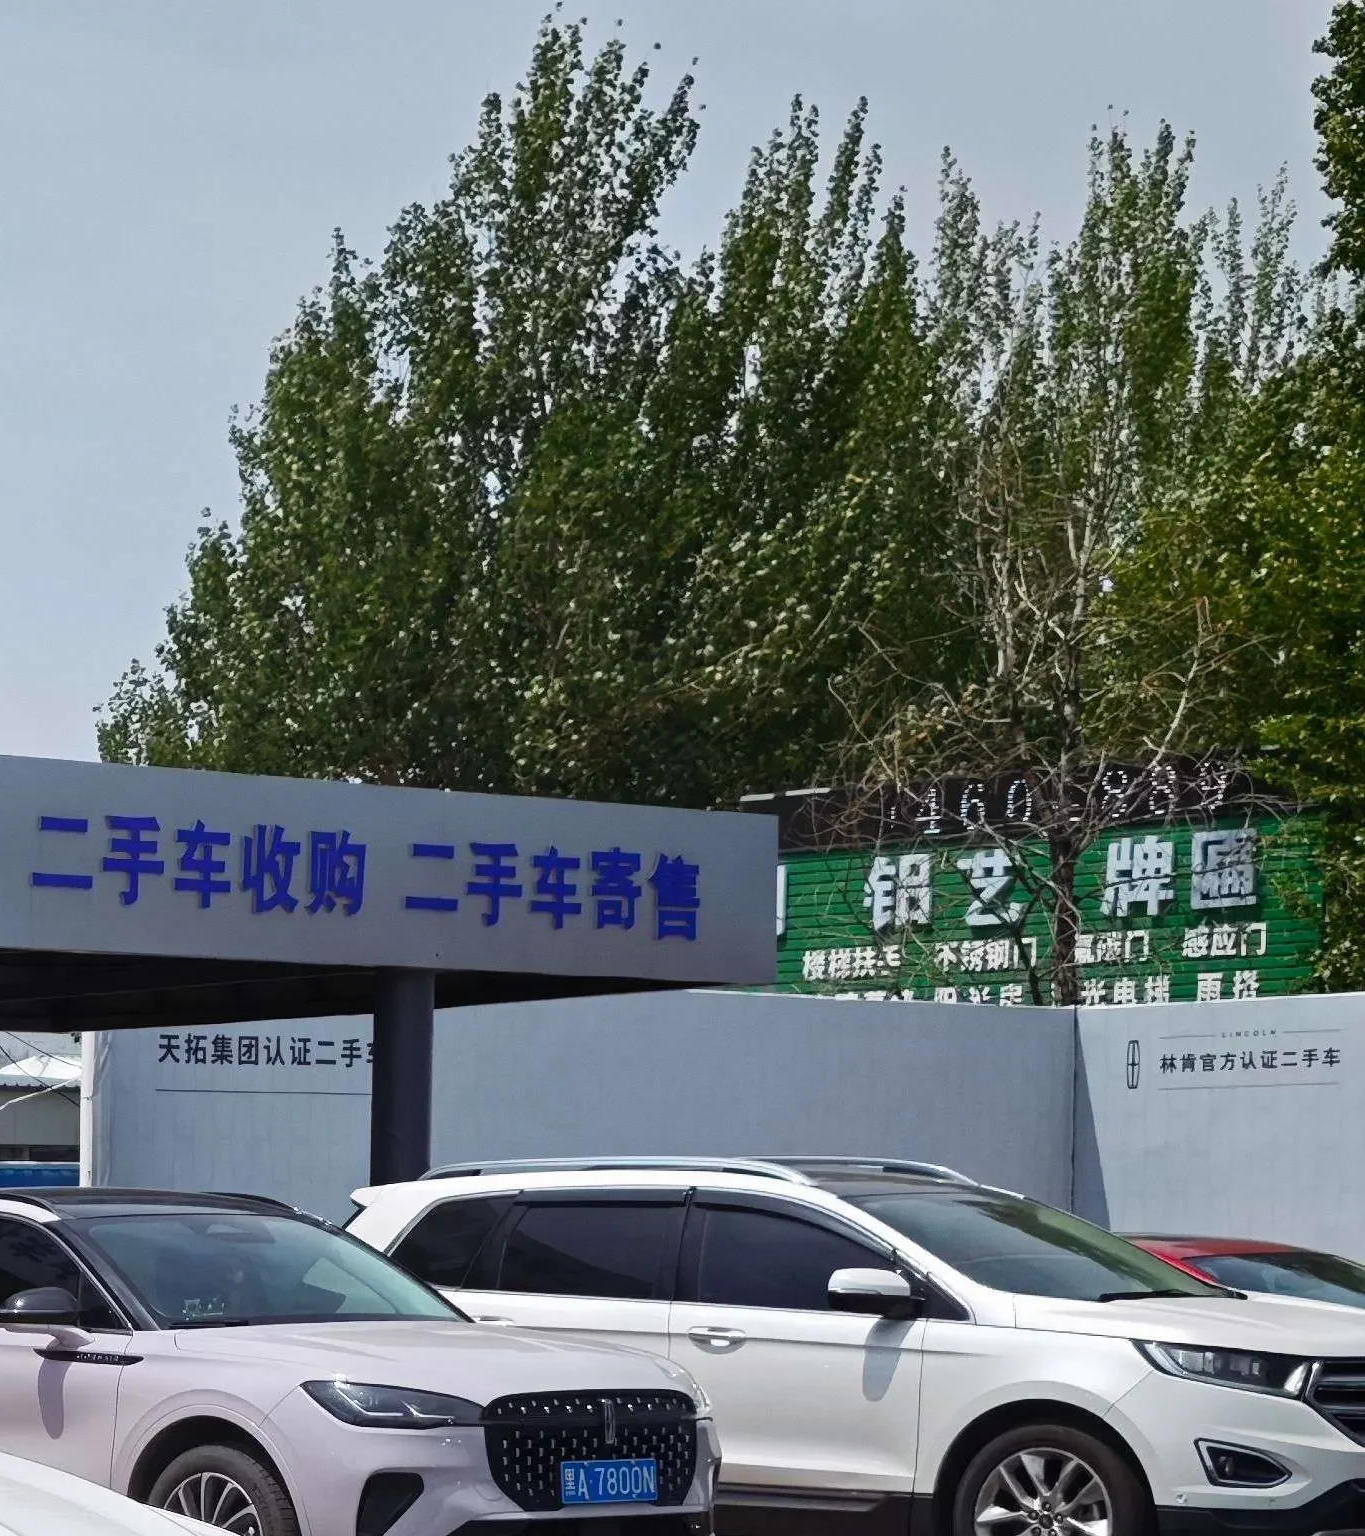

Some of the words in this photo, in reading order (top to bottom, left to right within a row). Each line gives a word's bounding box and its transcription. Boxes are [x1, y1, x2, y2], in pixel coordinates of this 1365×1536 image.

[32, 814, 367, 914] 二手车收购
[405, 842, 701, 942] 二手车寄售
[934, 937, 1037, 972] 不锈钢门
[1181, 922, 1267, 957] 感应门
[1159, 1047, 1341, 1074] 林肯官方认证二手车
